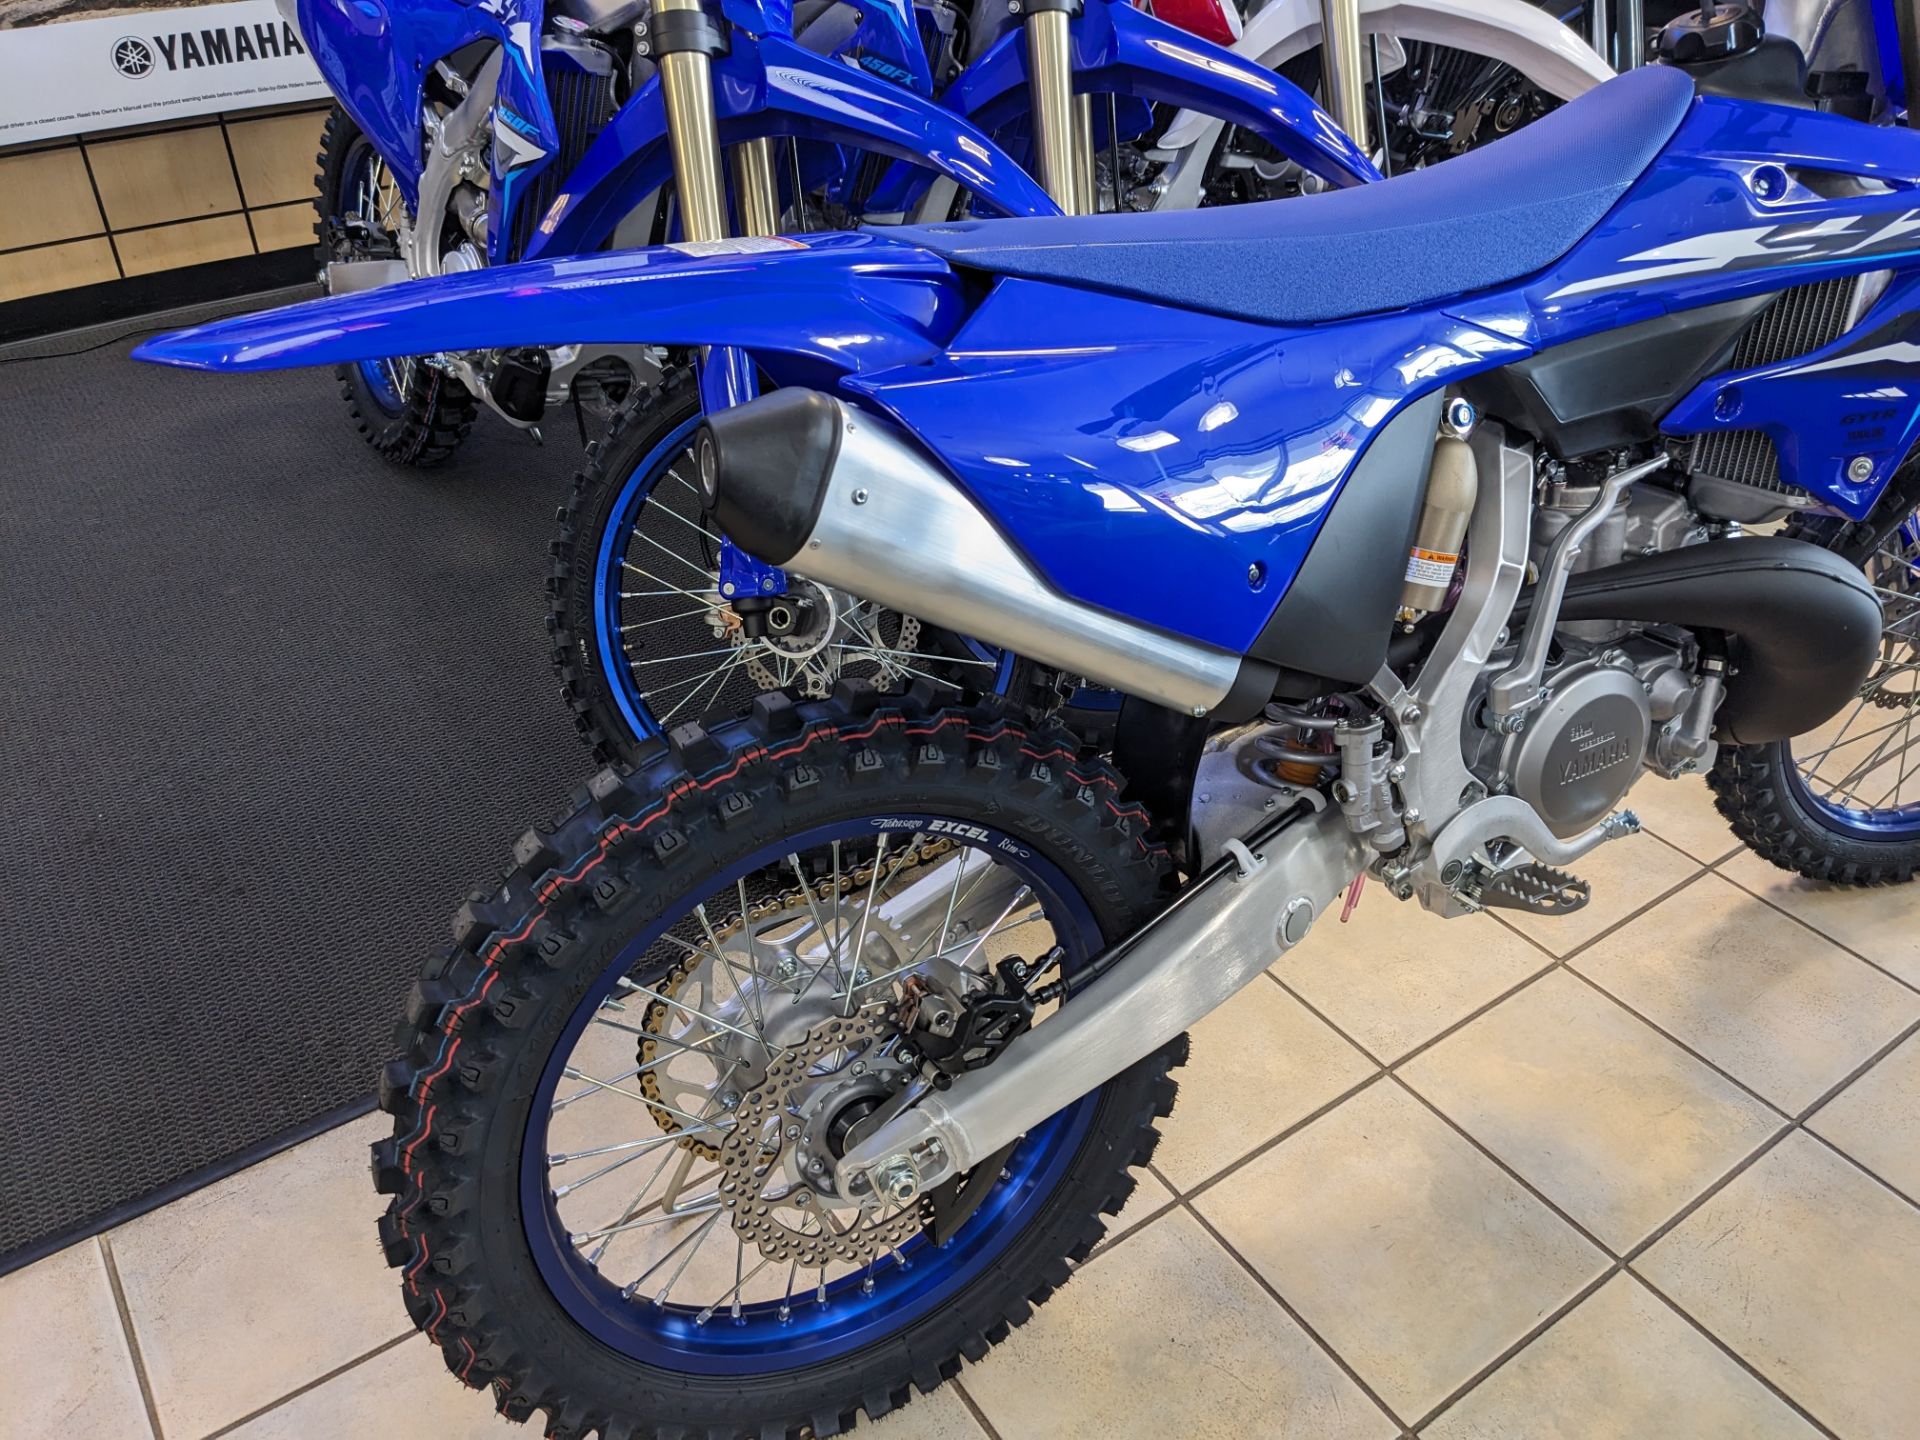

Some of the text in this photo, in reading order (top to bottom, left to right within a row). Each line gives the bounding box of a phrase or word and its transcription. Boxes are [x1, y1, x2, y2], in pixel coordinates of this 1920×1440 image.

[153, 21, 305, 71] YAMAHA
[1560, 737, 1630, 786] YAMAHA
[927, 819, 989, 843] EXCEL
[998, 838, 1024, 856] Rim
